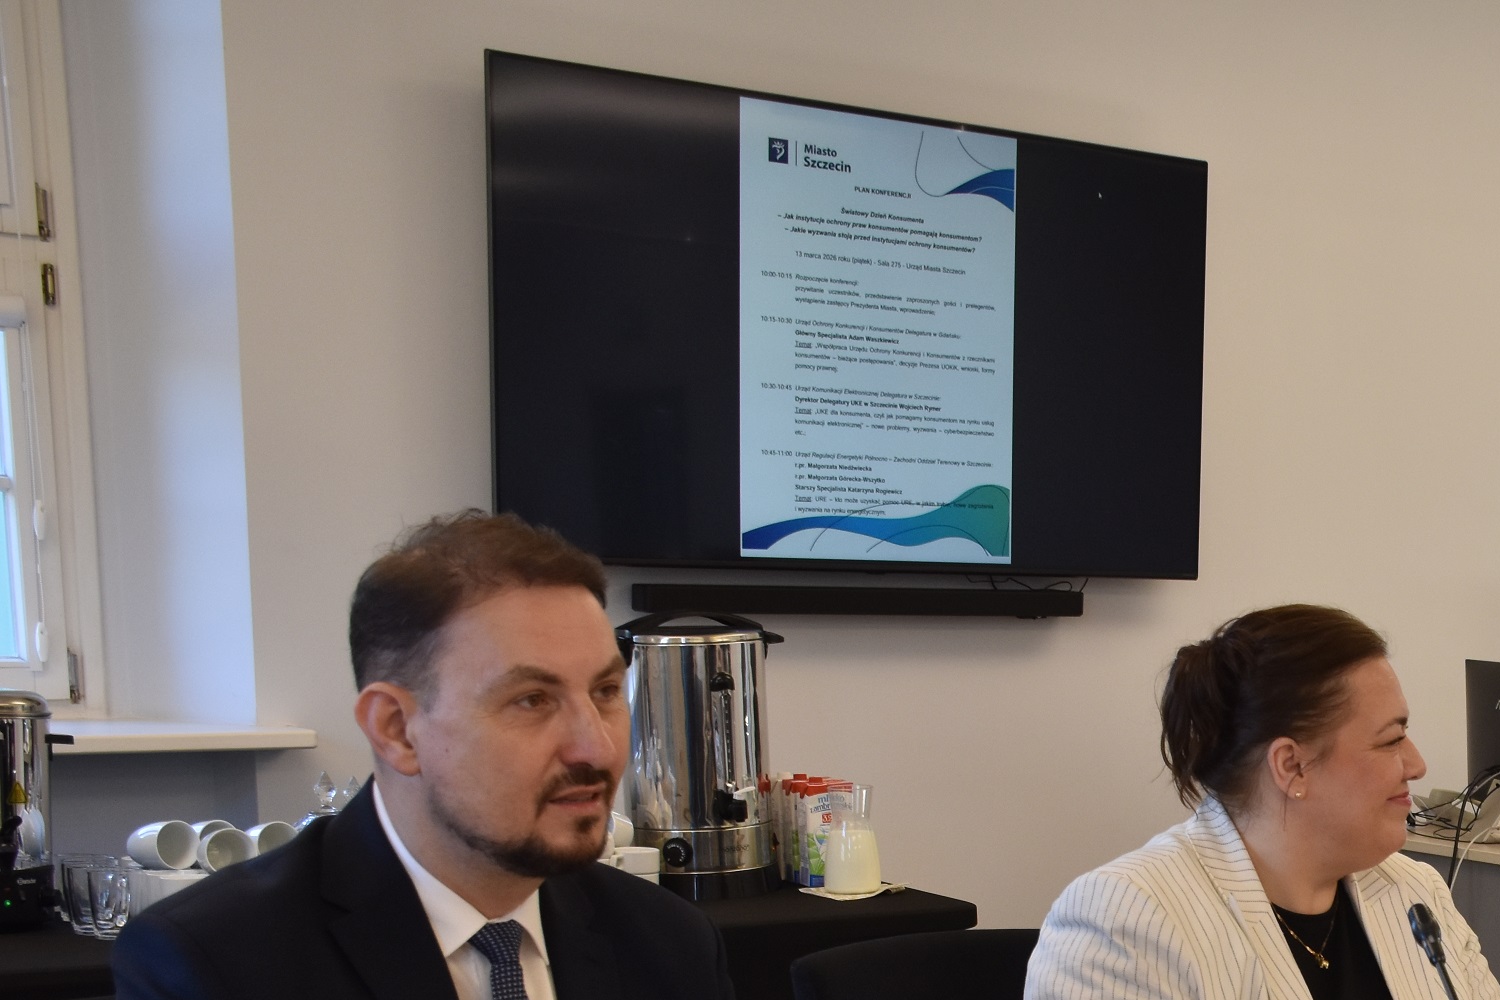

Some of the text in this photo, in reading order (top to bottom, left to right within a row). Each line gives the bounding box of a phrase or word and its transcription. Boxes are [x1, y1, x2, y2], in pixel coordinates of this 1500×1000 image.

[804, 144, 837, 157] Miasto
[804, 156, 851, 173] Szczecin
[871, 189, 911, 199] KONFERENCJI
[841, 207, 924, 224] Światowy Dzień Konsumenta
[796, 215, 825, 224] instytucje
[826, 219, 851, 228] ochrony
[868, 223, 909, 234] konsumentów
[910, 230, 938, 238] pomagają
[939, 232, 982, 242] konsumentom?
[872, 236, 907, 246] instytucjami
[908, 241, 932, 249] ochrony
[933, 243, 975, 253] konsumentów?
[795, 330, 816, 338] Główny
[817, 332, 847, 340] Specjalista
[795, 396, 819, 404] Dyrektor
[820, 398, 850, 407] Delegatury
[795, 484, 816, 492] Starszy
[817, 485, 846, 493] Specjalista
